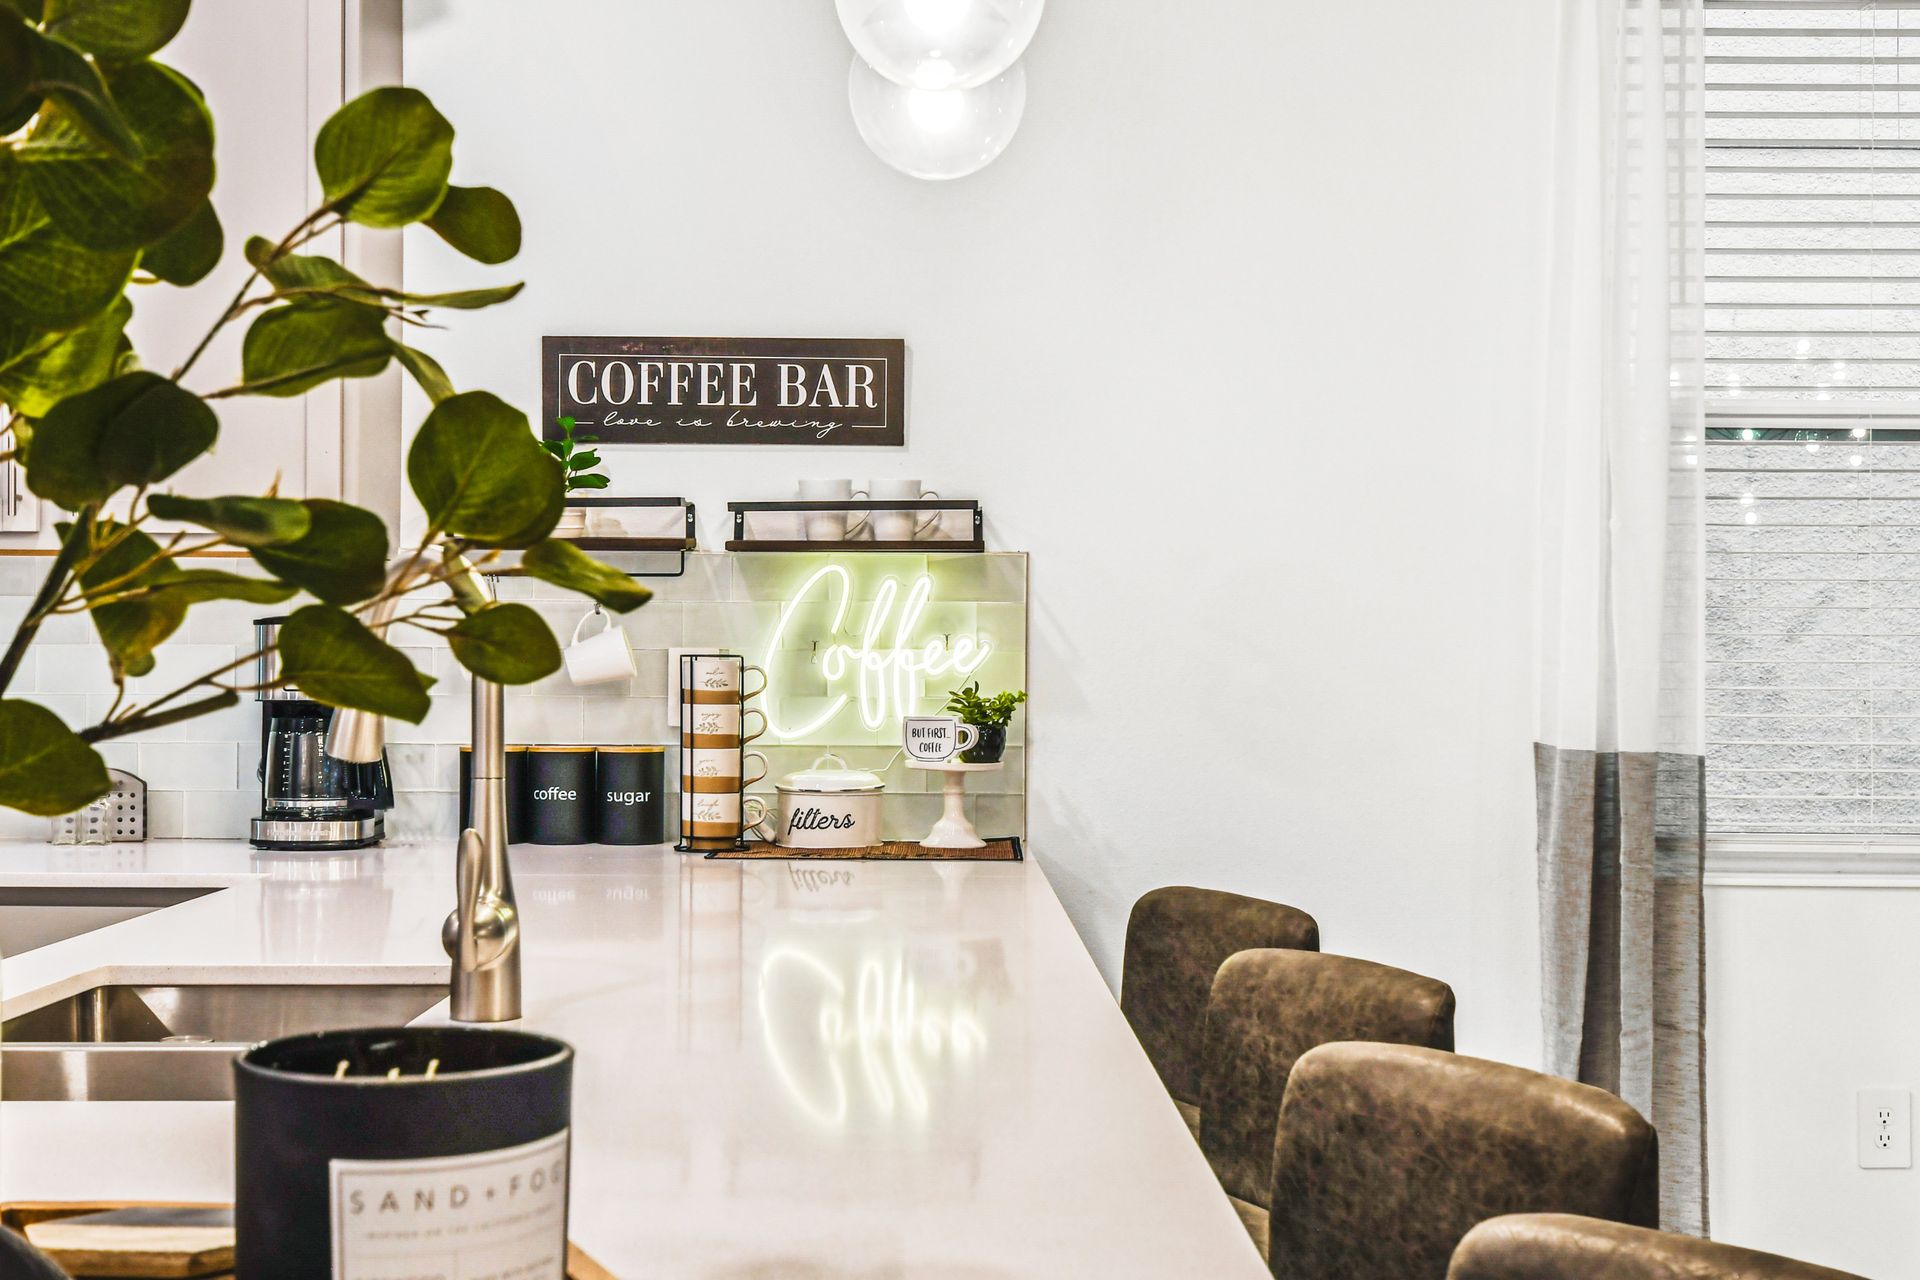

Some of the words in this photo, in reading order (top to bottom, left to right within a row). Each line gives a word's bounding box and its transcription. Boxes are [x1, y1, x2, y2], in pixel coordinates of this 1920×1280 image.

[567, 360, 757, 406] COFFEE
[776, 363, 878, 409] BAR
[603, 410, 661, 427] love
[676, 416, 712, 427] is
[726, 410, 843, 439] brewing
[760, 563, 992, 739] Coffee
[911, 727, 925, 738] BUT
[919, 742, 942, 753] COFFEE
[533, 787, 577, 801] coffee
[606, 790, 651, 806] sugar
[787, 807, 856, 836] filters
[349, 1184, 470, 1215] SAND
